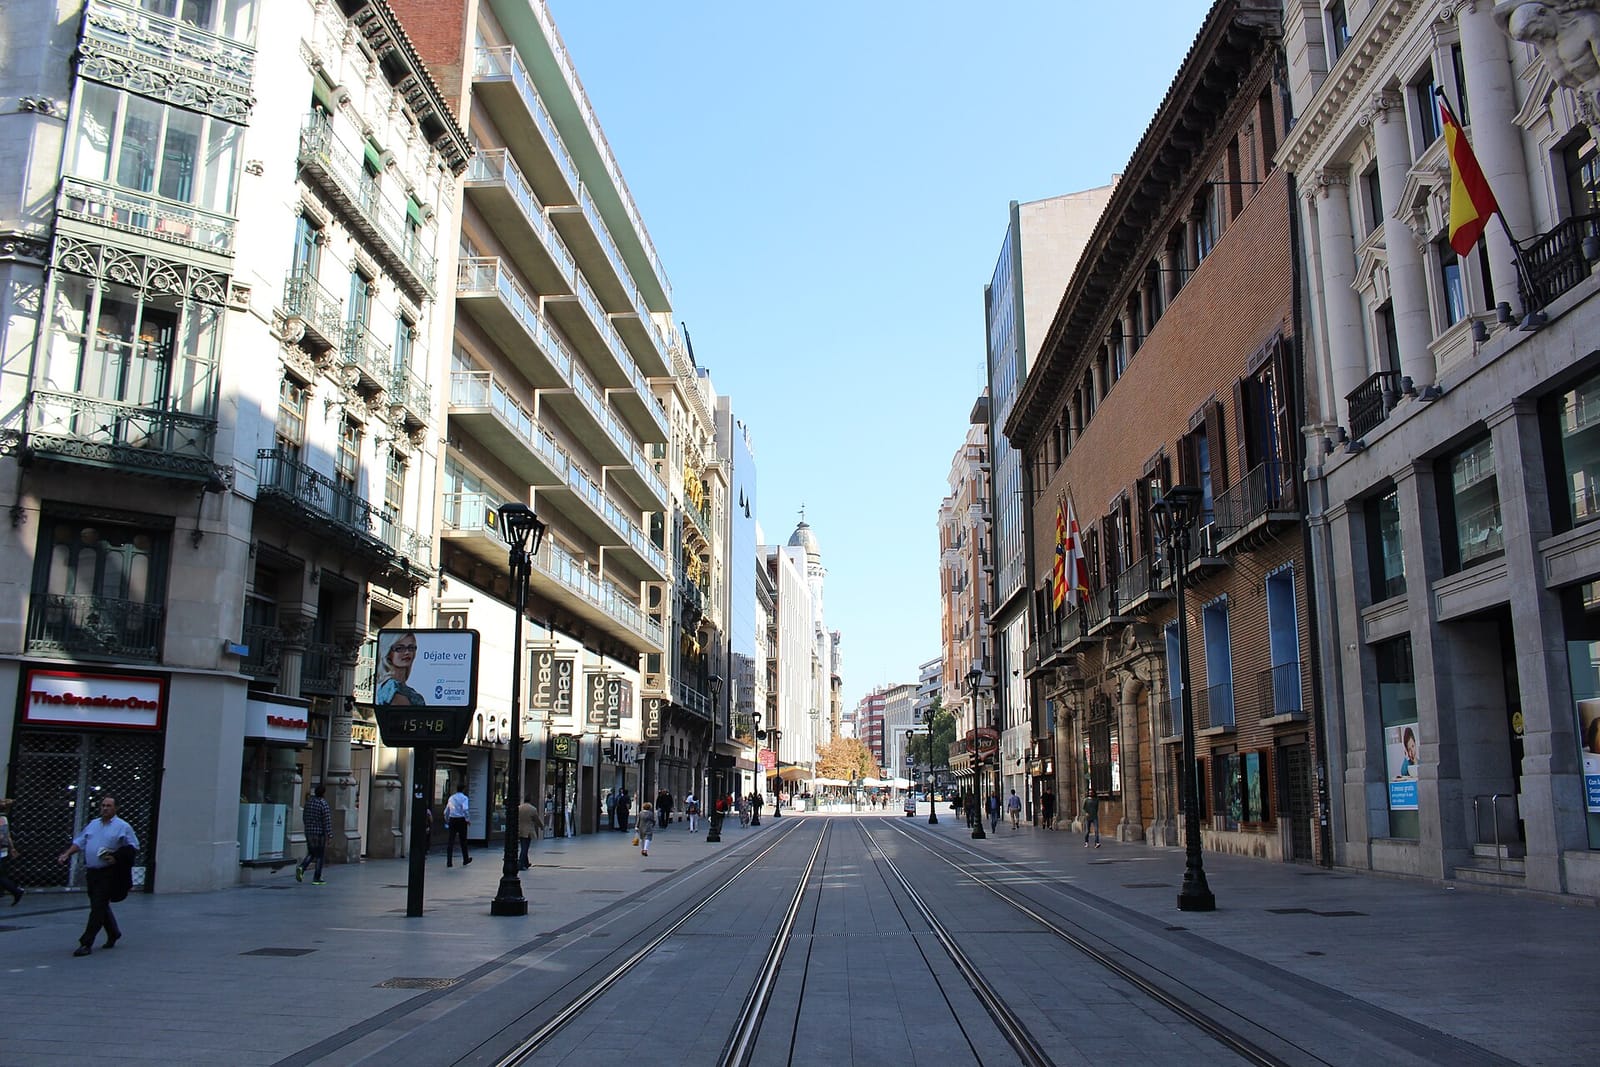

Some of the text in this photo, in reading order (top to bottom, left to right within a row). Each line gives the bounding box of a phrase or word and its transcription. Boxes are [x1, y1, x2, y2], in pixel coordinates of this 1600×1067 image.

[424, 652, 451, 661] Déjate
[533, 653, 551, 708] fnac
[553, 662, 571, 714] fnac
[589, 676, 605, 723] fnac
[31, 691, 158, 710] TheSneakerOne
[606, 682, 619, 728] fnac
[647, 699, 659, 738] fnac
[403, 720, 443, 731] 15:48
[464, 706, 512, 744] nac
